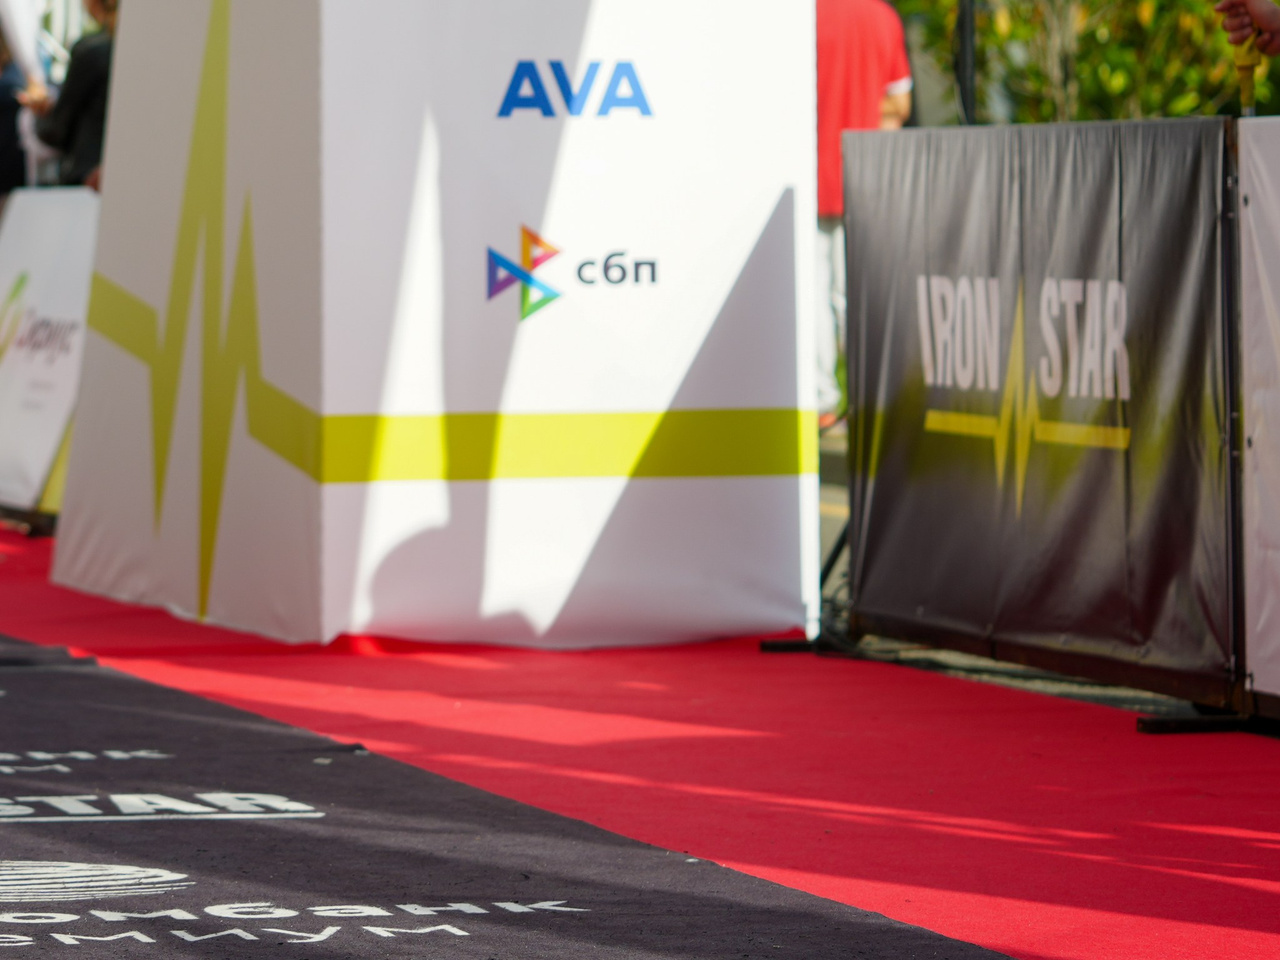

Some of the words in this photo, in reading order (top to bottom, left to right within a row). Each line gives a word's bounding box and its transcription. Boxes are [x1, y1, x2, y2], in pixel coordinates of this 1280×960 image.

[497, 60, 653, 118] AVA
[577, 252, 658, 284] сбп
[917, 275, 1000, 392] IRON
[1039, 276, 1131, 401] STAR
